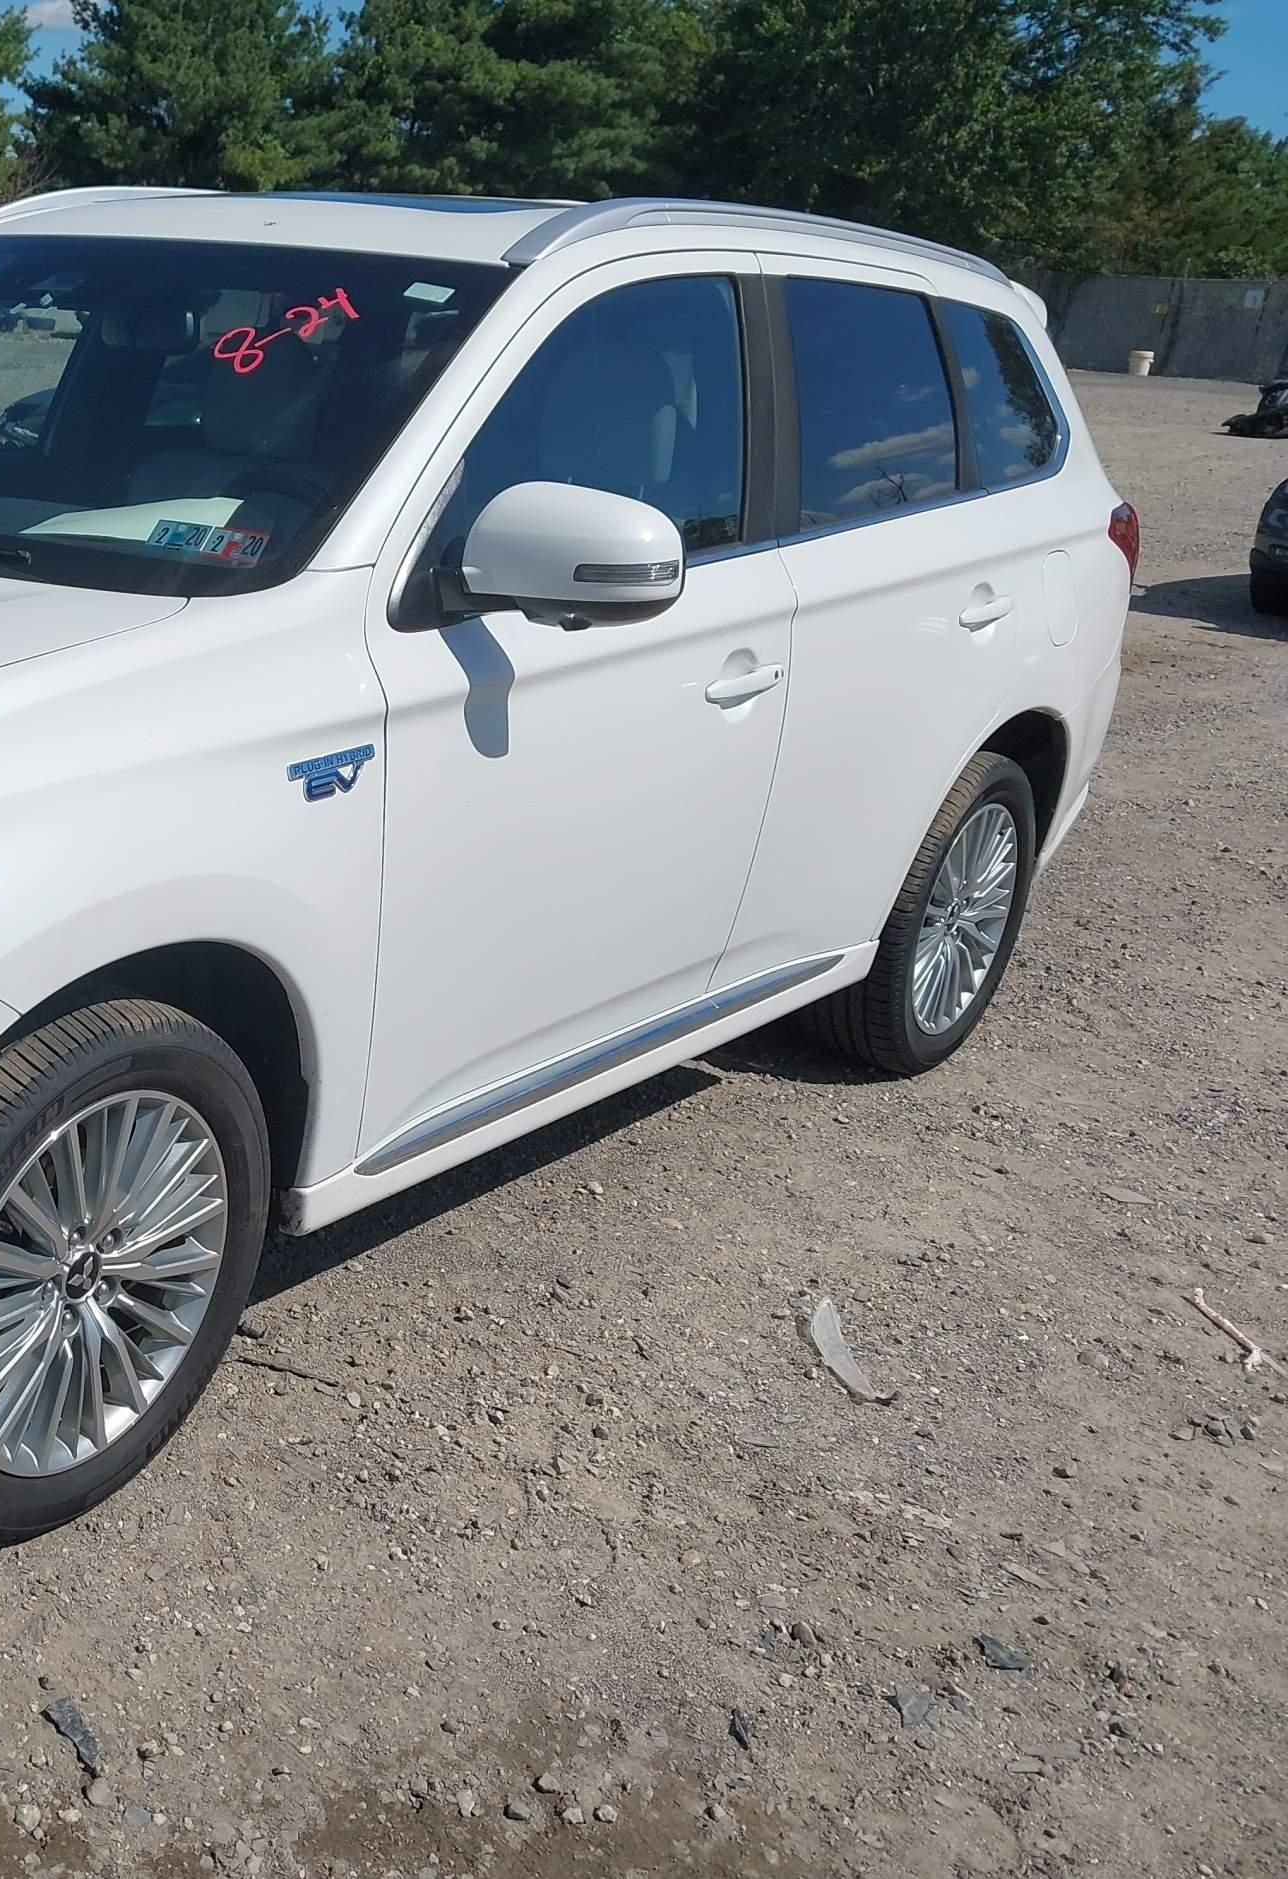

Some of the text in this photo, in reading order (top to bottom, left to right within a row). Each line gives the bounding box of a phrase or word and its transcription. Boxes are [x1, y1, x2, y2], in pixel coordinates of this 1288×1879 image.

[185, 527, 208, 547] 20
[241, 535, 264, 556] 20
[336, 748, 372, 763] HYBRID
[303, 762, 364, 802] EV
